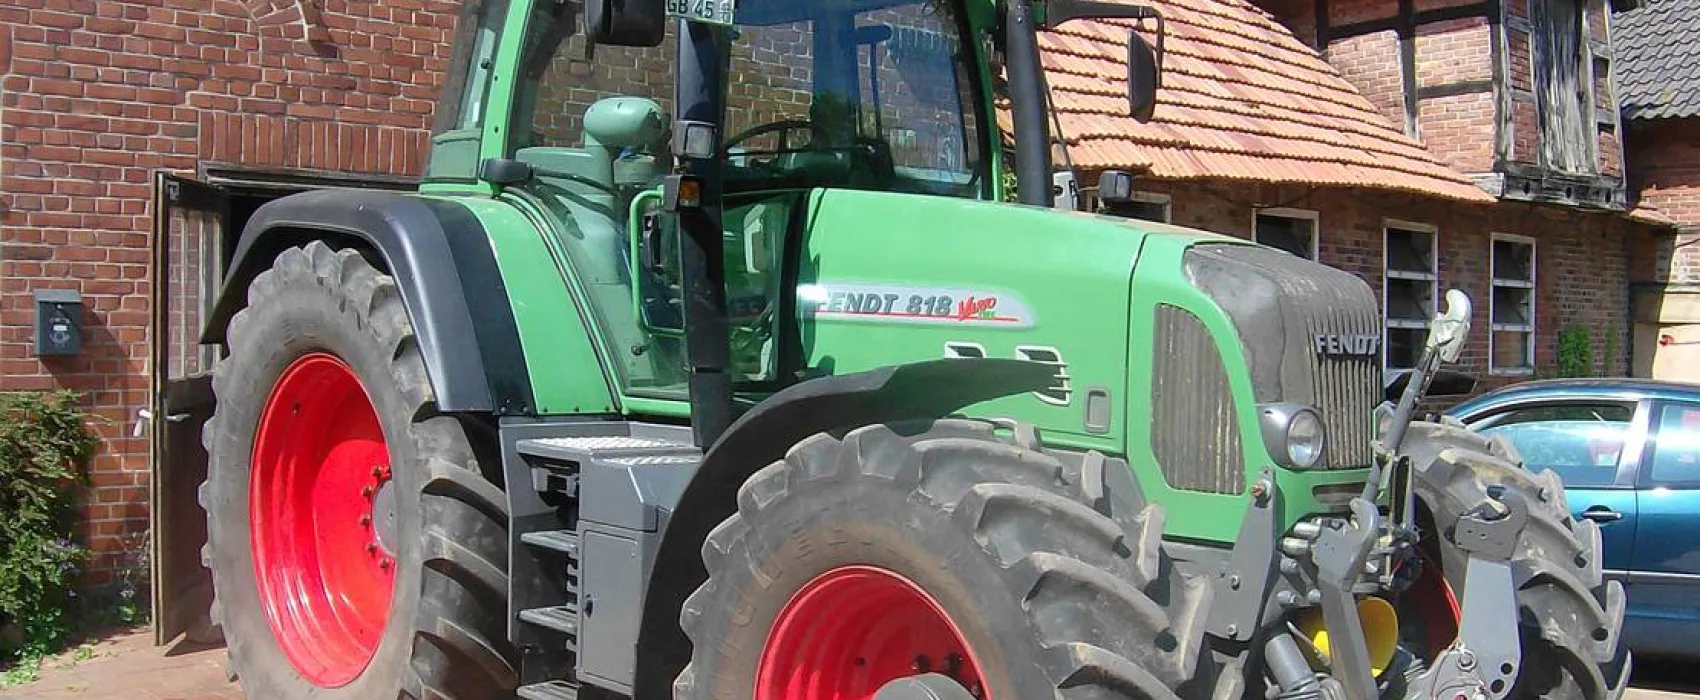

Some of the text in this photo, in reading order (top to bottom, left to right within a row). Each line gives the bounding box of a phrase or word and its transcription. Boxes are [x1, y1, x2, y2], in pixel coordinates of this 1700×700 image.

[692, 0, 714, 19] 45
[906, 295, 952, 316] 818
[1315, 334, 1380, 355] FENDT
